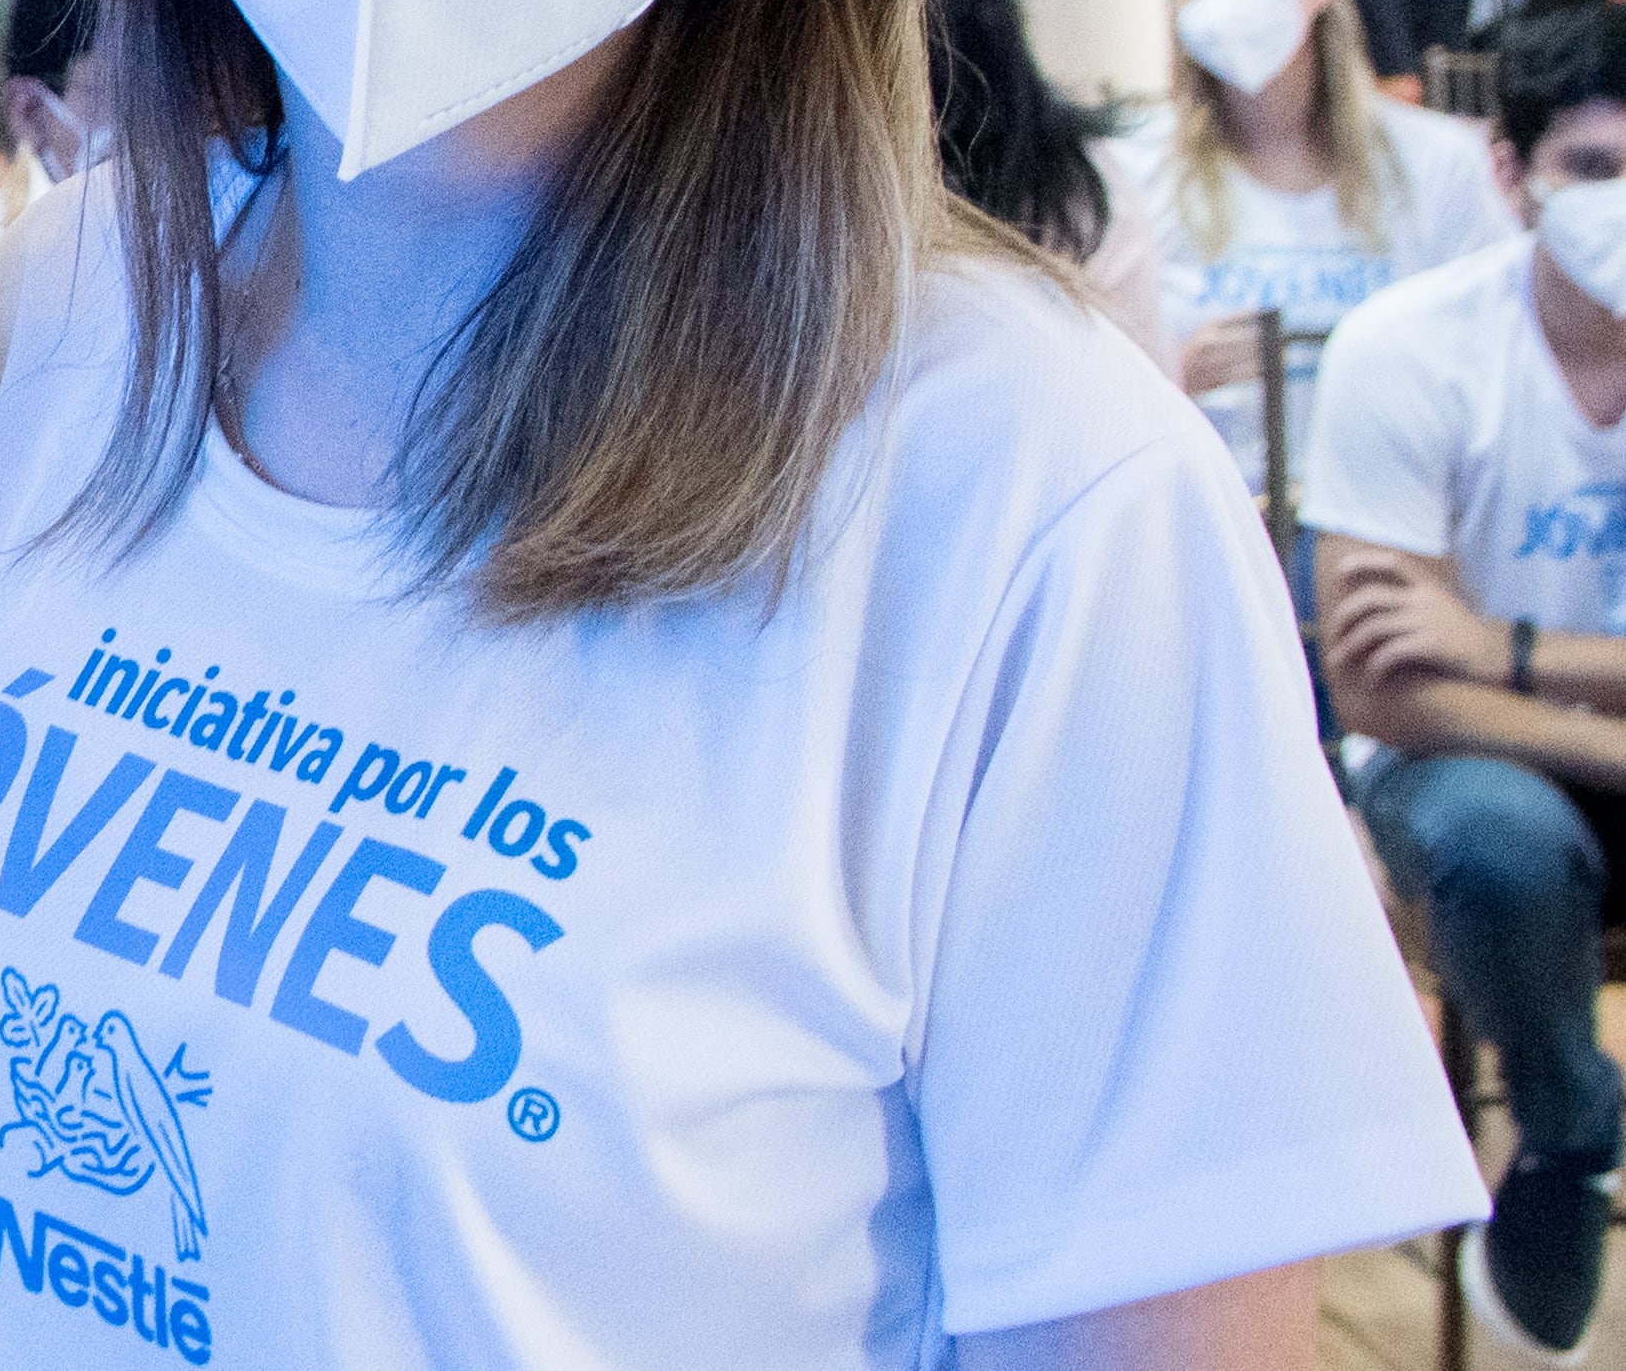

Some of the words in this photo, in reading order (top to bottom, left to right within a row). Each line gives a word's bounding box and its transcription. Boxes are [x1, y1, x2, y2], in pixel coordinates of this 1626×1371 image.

[68, 627, 344, 785] iniciativa
[334, 741, 467, 819] por
[462, 766, 592, 881] los
